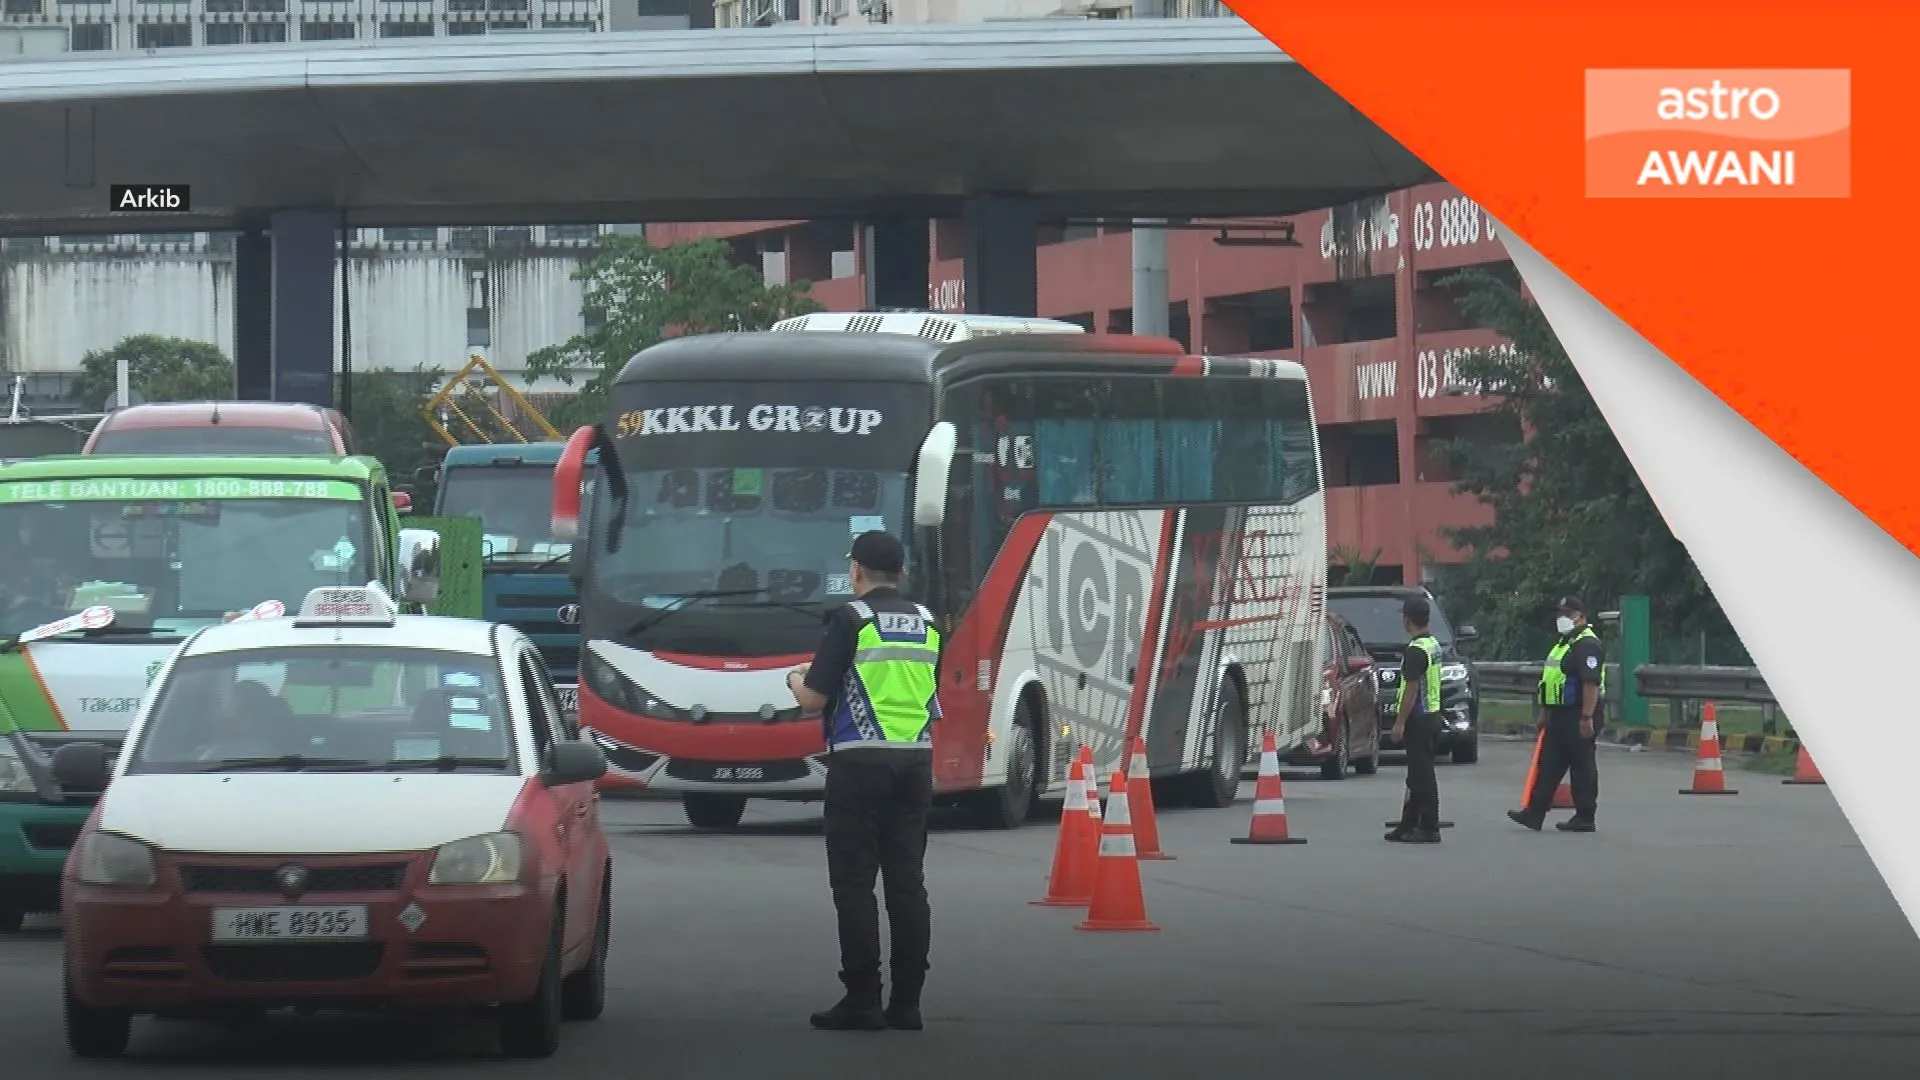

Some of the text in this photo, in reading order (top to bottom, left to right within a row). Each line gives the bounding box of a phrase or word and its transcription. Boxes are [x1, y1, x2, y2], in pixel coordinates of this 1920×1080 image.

[1414, 202, 1435, 251] 03
[1440, 196, 1481, 248] 8888
[1418, 350, 1438, 398] 03
[616, 405, 884, 439] 59 KKKL GROUP
[9, 481, 62, 498] TELE
[69, 480, 184, 497] BANTUAN:
[321, 590, 367, 602] TEKSI
[314, 604, 373, 616] BERMETER
[883, 615, 919, 632] JPJ
[234, 909, 351, 937] HWE 8935
